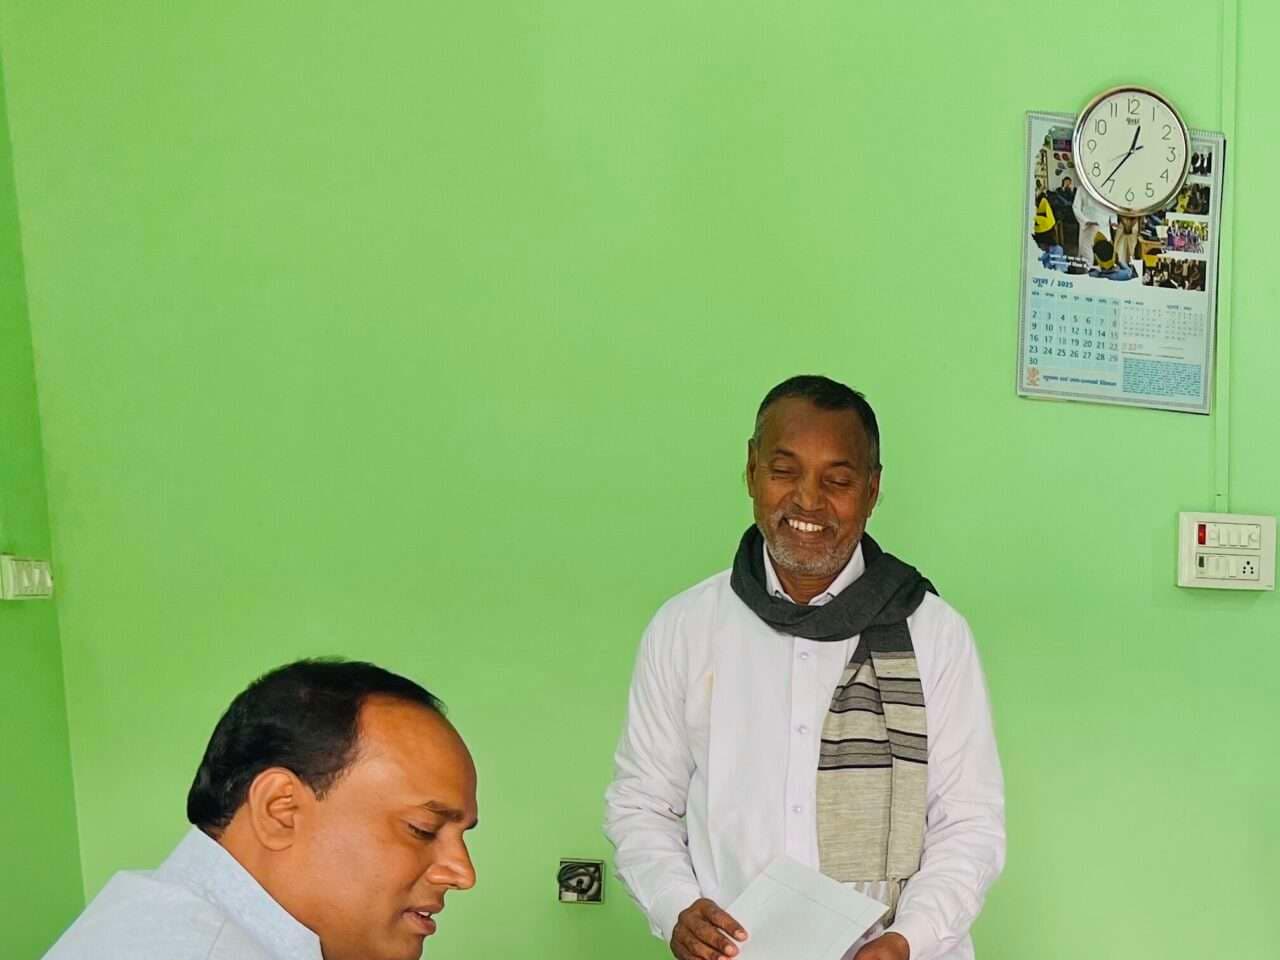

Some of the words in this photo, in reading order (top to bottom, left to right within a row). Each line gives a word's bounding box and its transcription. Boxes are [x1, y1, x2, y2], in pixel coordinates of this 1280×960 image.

[1110, 102, 1118, 117] 11
[1151, 106, 1156, 121] 1
[1127, 98, 1141, 115] 12
[1094, 119, 1107, 136] 10
[1162, 124, 1173, 141] 2
[1087, 139, 1097, 154] 9
[1166, 147, 1176, 162] 3
[1091, 162, 1101, 177] 8
[1160, 168, 1169, 183] 4
[1107, 178, 1116, 194] 7
[1144, 182, 1155, 199] 5
[1124, 188, 1135, 202] 6
